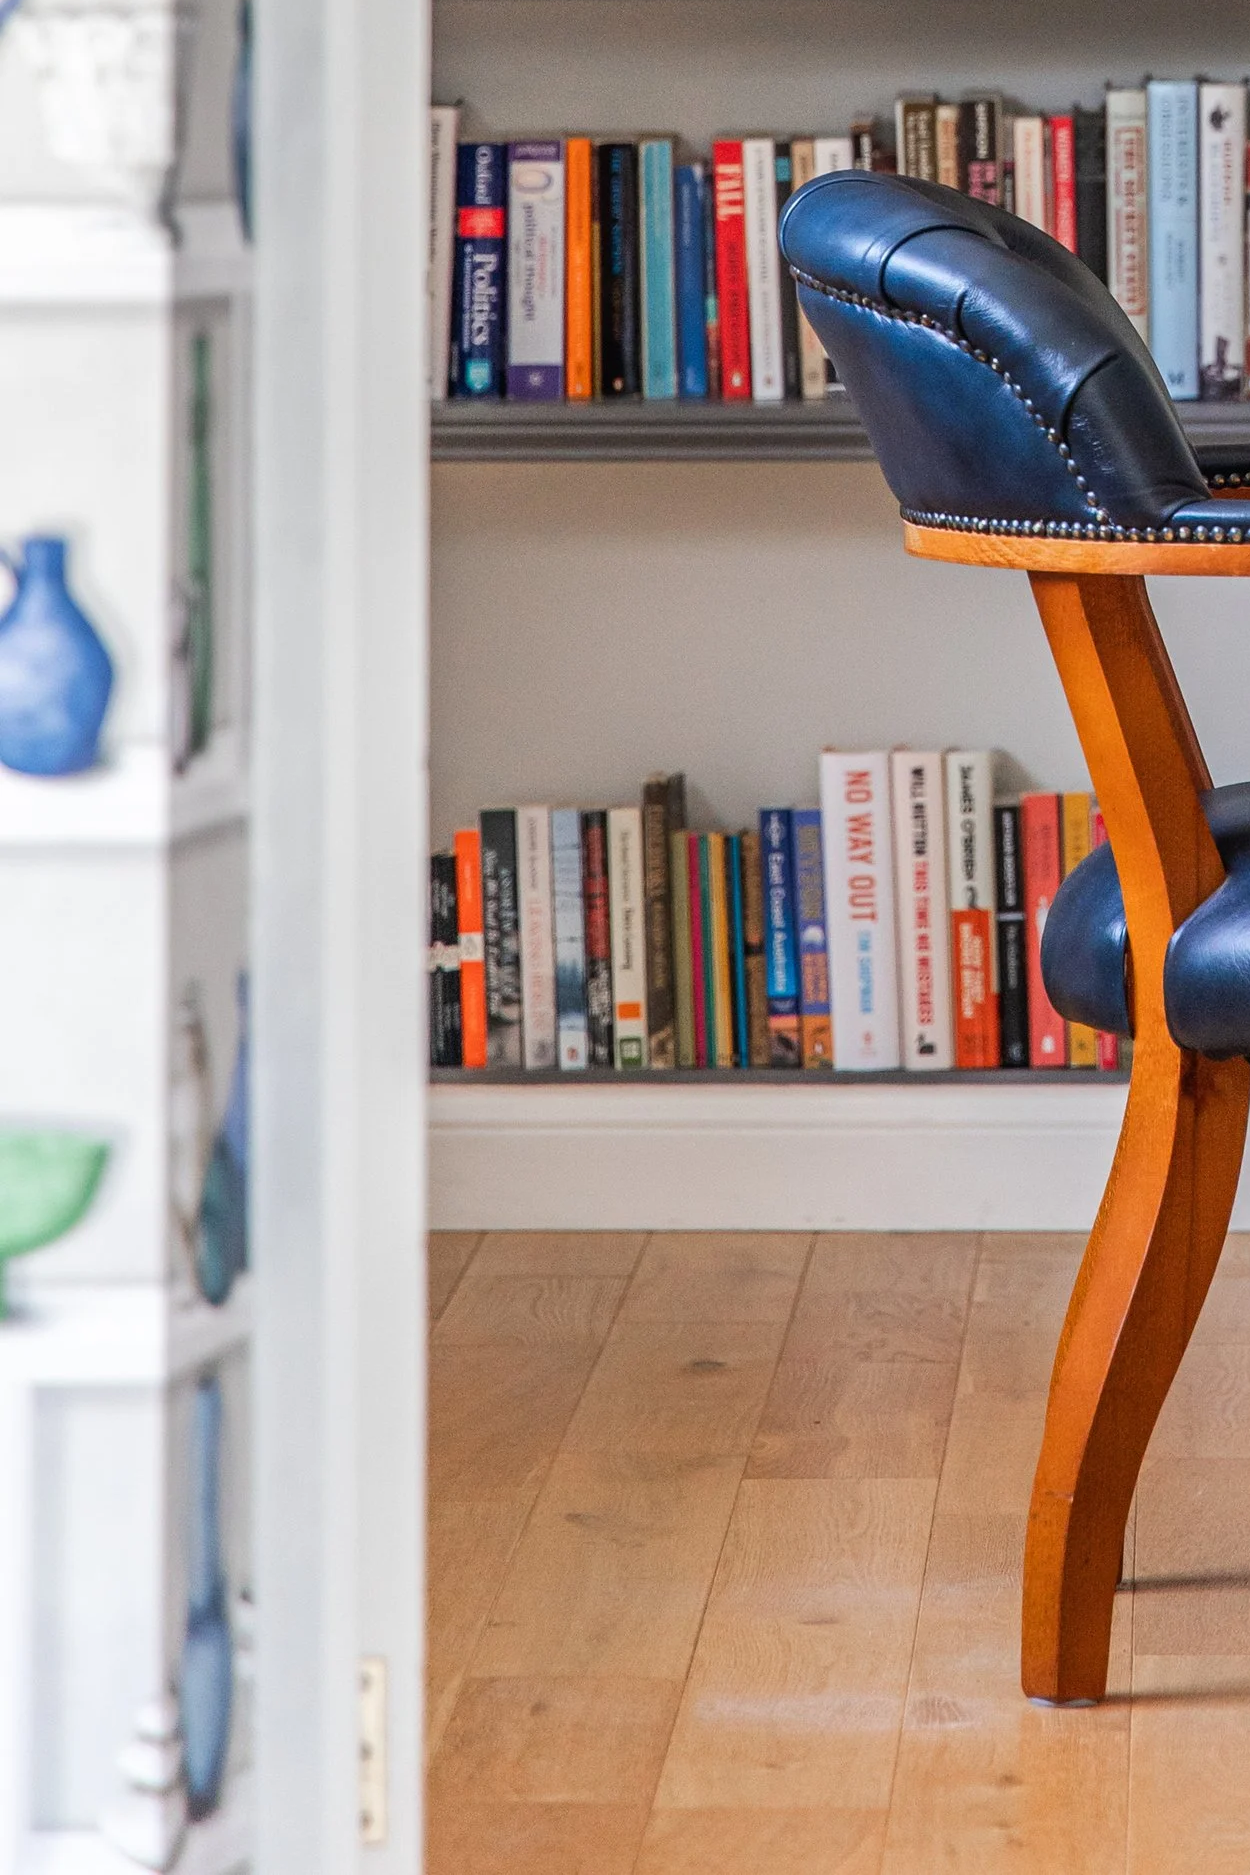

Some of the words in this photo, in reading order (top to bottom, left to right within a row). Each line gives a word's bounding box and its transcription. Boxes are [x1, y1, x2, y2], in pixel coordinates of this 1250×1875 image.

[475, 147, 490, 204] Oxford
[1056, 127, 1070, 181] WOMEN
[1123, 138, 1136, 169] THE
[716, 164, 743, 221] FALL
[523, 204, 535, 262] political
[472, 253, 498, 345] Politics
[522, 267, 536, 321] thought
[844, 770, 872, 804] NO
[910, 766, 924, 798] WILL
[959, 765, 974, 815] JAMES
[846, 814, 873, 865] WAY
[911, 803, 926, 856] HUTTON
[768, 853, 783, 885] East
[914, 862, 927, 892] THIS
[770, 887, 785, 928] Coast
[848, 875, 876, 924] OUT
[915, 896, 929, 930] TIME
[772, 931, 787, 993] Australia
[916, 934, 930, 952] NO
[916, 956, 933, 1025] MISTAKES
